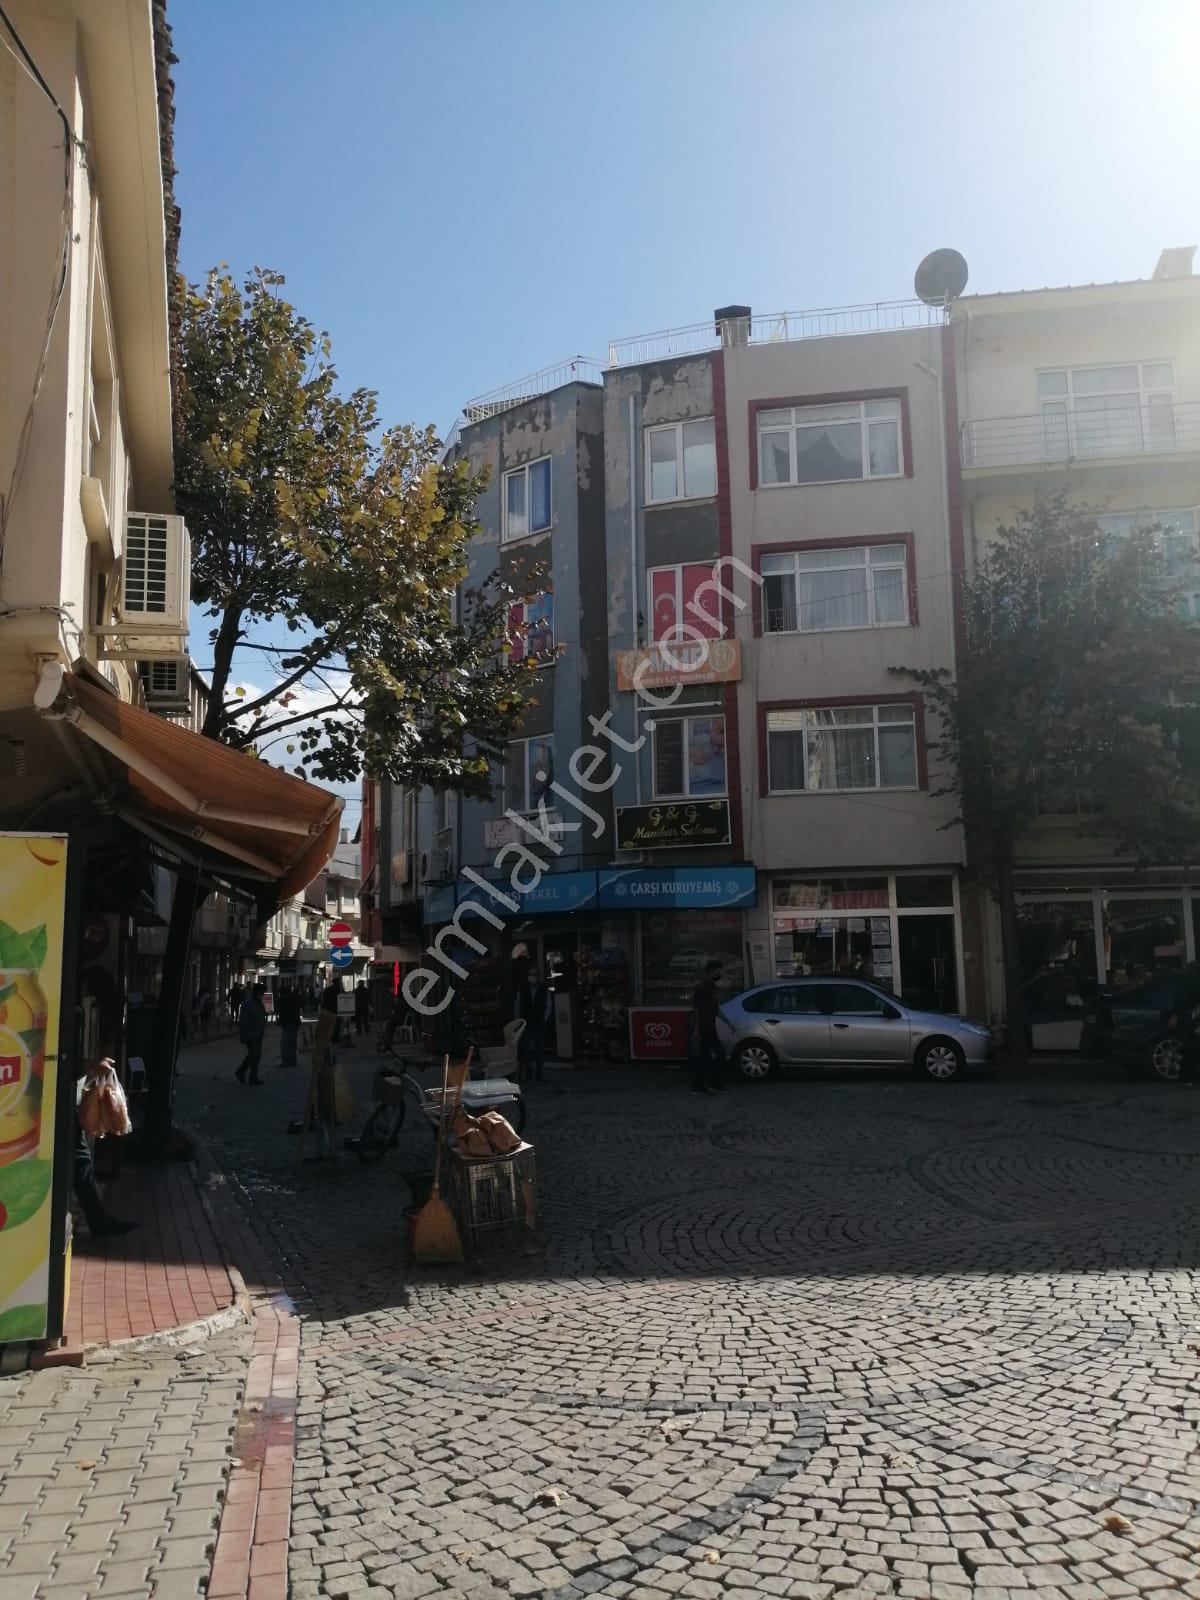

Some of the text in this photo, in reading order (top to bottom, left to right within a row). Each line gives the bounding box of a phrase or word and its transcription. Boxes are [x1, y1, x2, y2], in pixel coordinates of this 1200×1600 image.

[649, 804, 700, 826] G & G
[524, 887, 560, 902] TEKEL
[630, 880, 722, 897] ÇARŞI KURUYEMİŞ
